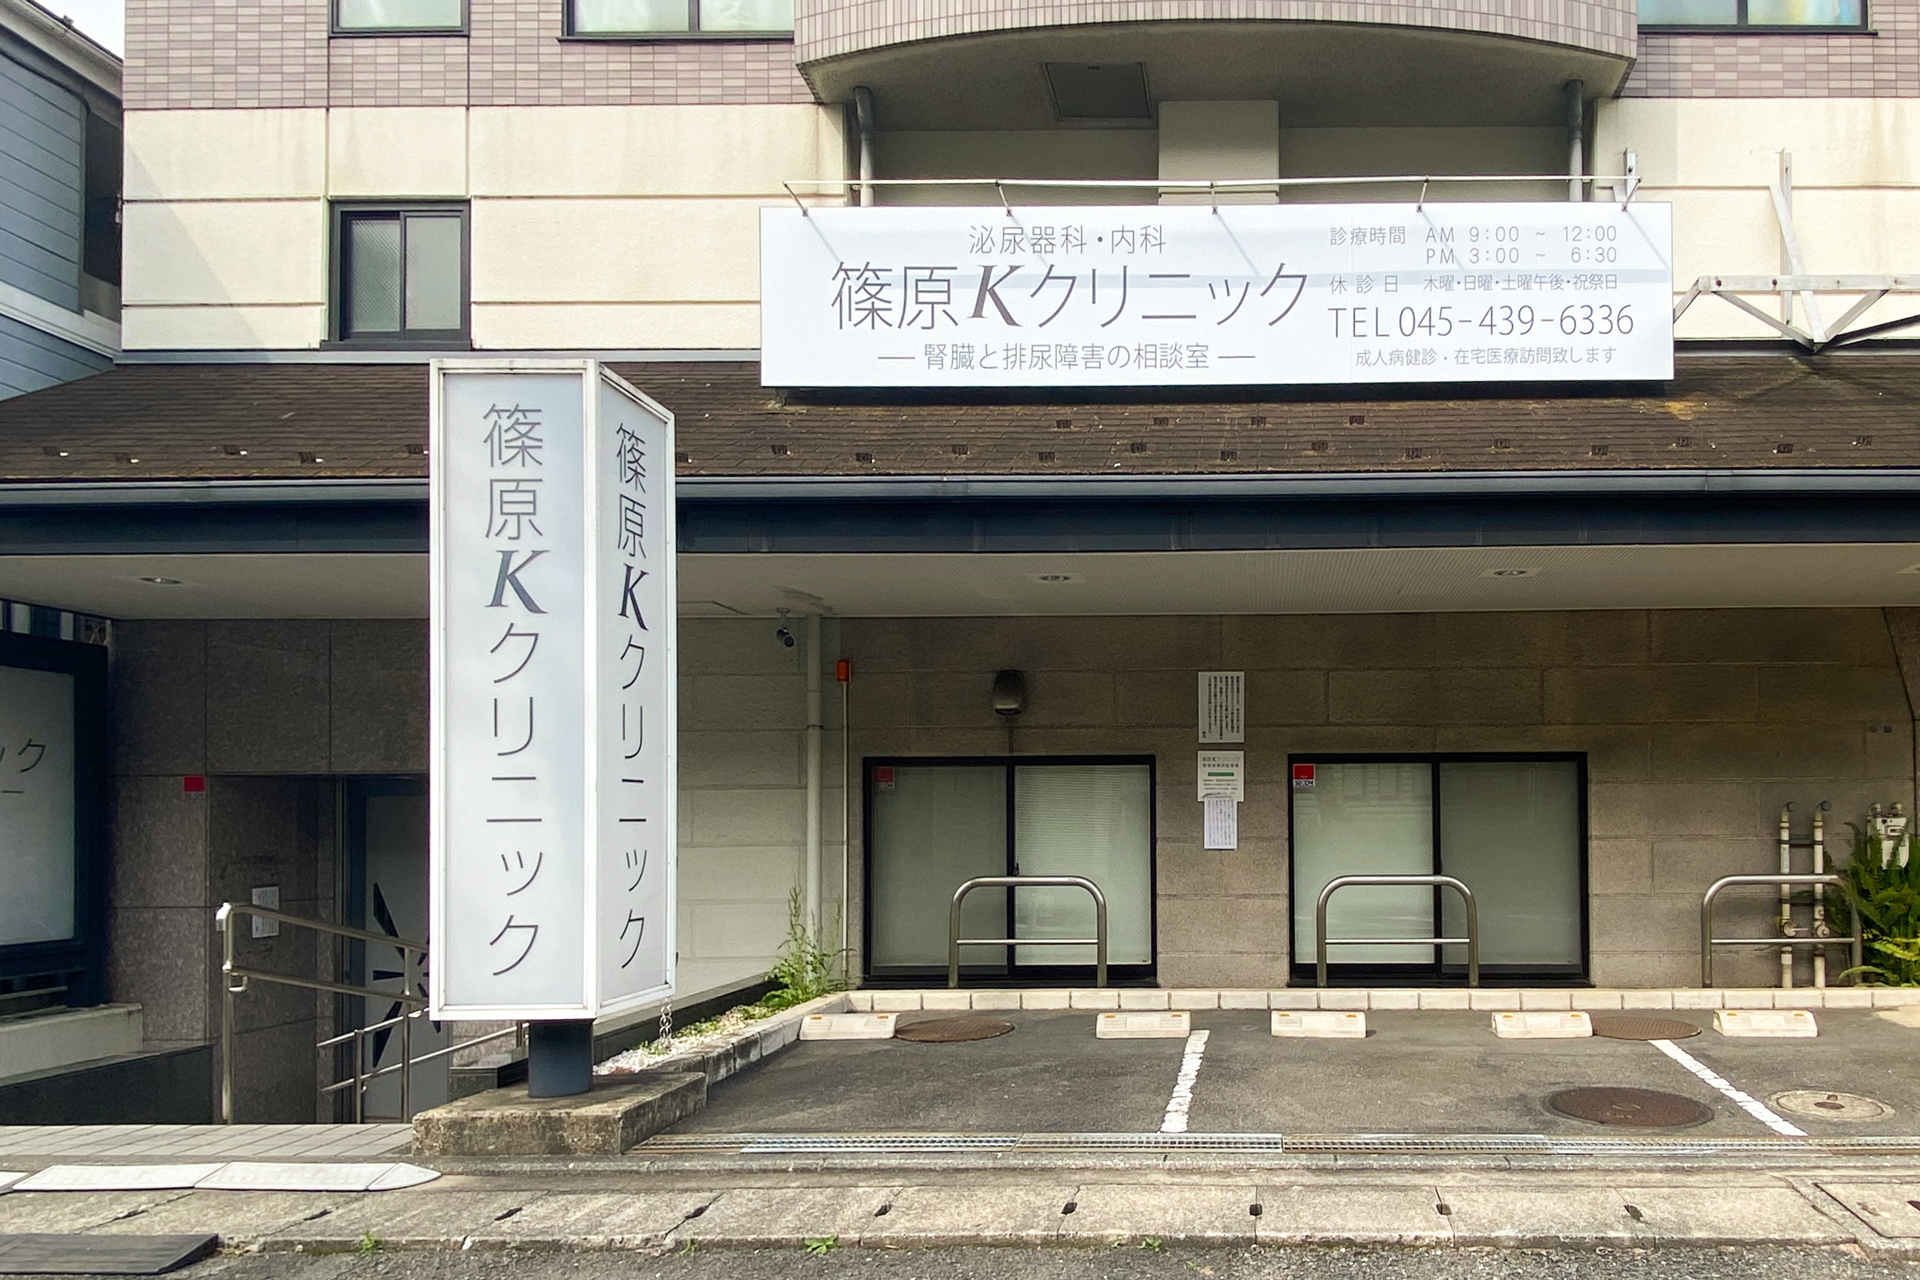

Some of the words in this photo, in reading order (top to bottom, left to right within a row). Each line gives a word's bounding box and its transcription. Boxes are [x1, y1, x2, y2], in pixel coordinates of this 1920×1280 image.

[968, 225, 1167, 255] 泌尿器科・内科
[1329, 226, 1406, 246] 診療時間
[1425, 226, 1455, 243] AM
[1469, 226, 1519, 242] 9:00
[1563, 225, 1617, 242] 12:00
[1426, 247, 1455, 264] PM
[1469, 247, 1519, 264] 3:00
[1571, 247, 1617, 263] 6:30
[831, 261, 1308, 331] 篠原Kクリニック
[1328, 307, 1391, 339] TEL
[483, 403, 550, 977] 篠原Kクリニック
[616, 422, 649, 969] 篠原Kクリニック
